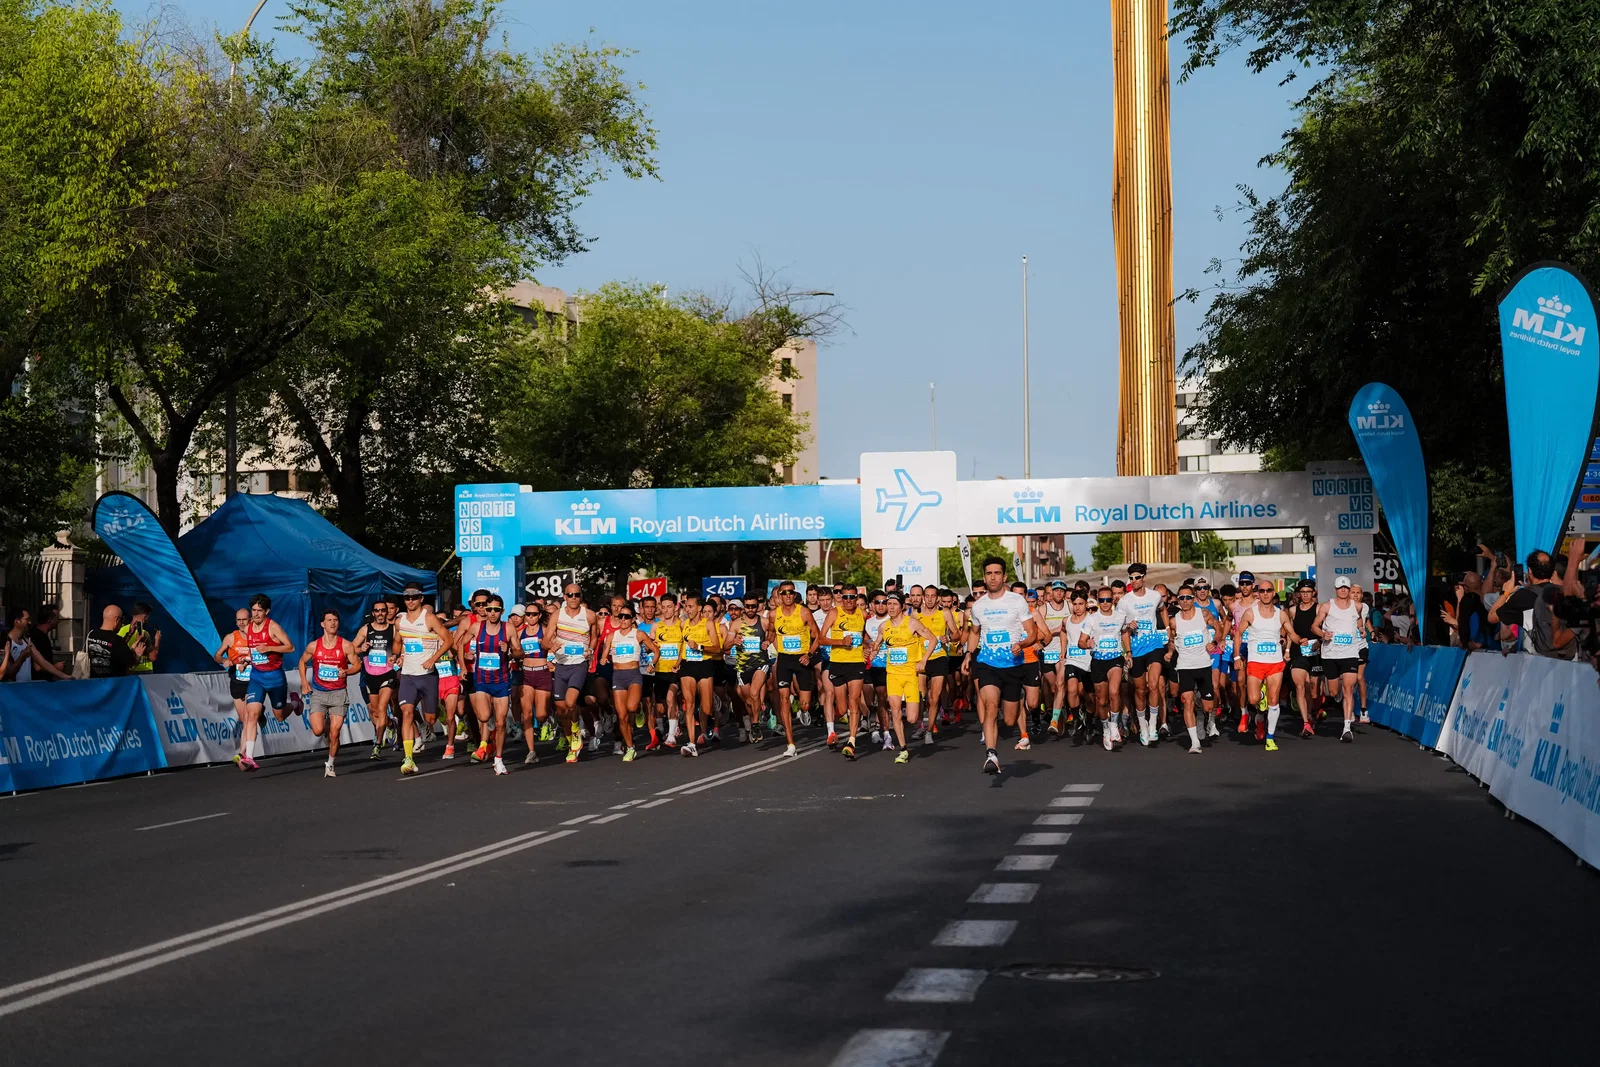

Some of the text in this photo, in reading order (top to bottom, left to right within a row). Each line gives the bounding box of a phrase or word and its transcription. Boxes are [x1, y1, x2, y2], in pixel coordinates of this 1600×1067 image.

[1314, 480, 1371, 495] NORTE
[460, 501, 515, 517] NORTE
[1351, 496, 1372, 511] VS
[997, 500, 1277, 526] KLM Royal Dutch Airlines
[460, 520, 481, 534] VS
[555, 513, 825, 538] KLM Royal Dutch Airlines
[1339, 514, 1373, 530] SUR
[461, 536, 492, 551] SUR
[319, 669, 337, 677] 4201
[201, 717, 231, 745] Royal
[24, 734, 59, 767] Royal
[57, 730, 98, 758] Dutch
[96, 726, 142, 754] Airlines
[1530, 738, 1562, 786] KLM
